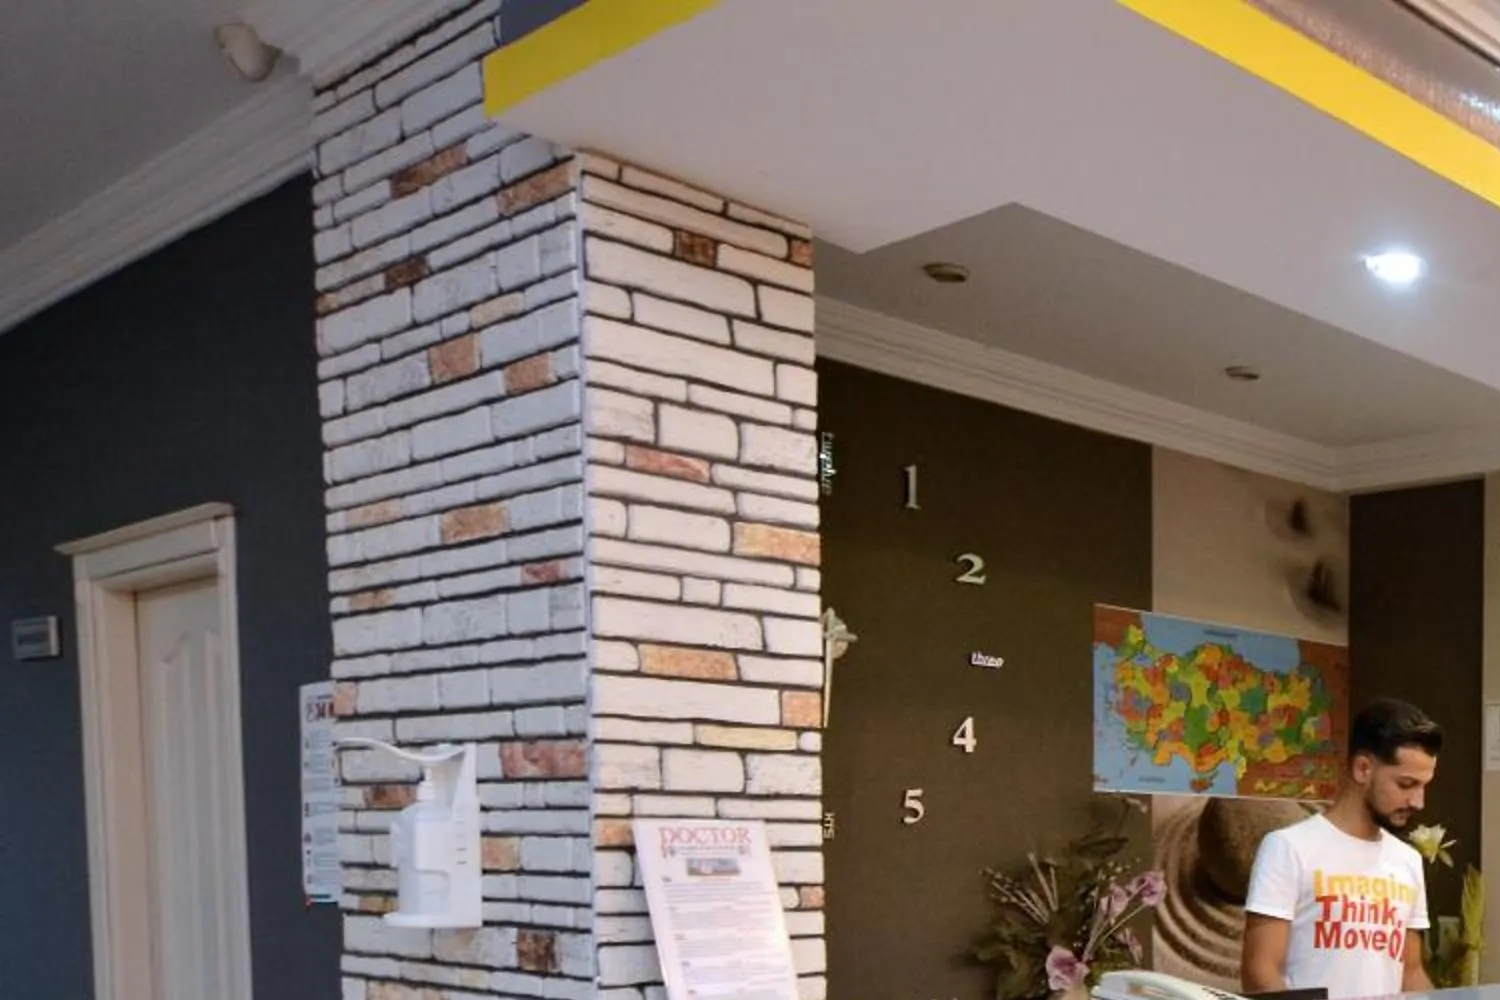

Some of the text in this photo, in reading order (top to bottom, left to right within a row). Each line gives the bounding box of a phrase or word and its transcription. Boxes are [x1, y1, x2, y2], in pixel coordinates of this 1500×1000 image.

[903, 463, 921, 510] 1
[956, 553, 986, 585] 2
[953, 716, 977, 753] 4
[904, 788, 925, 824] 5
